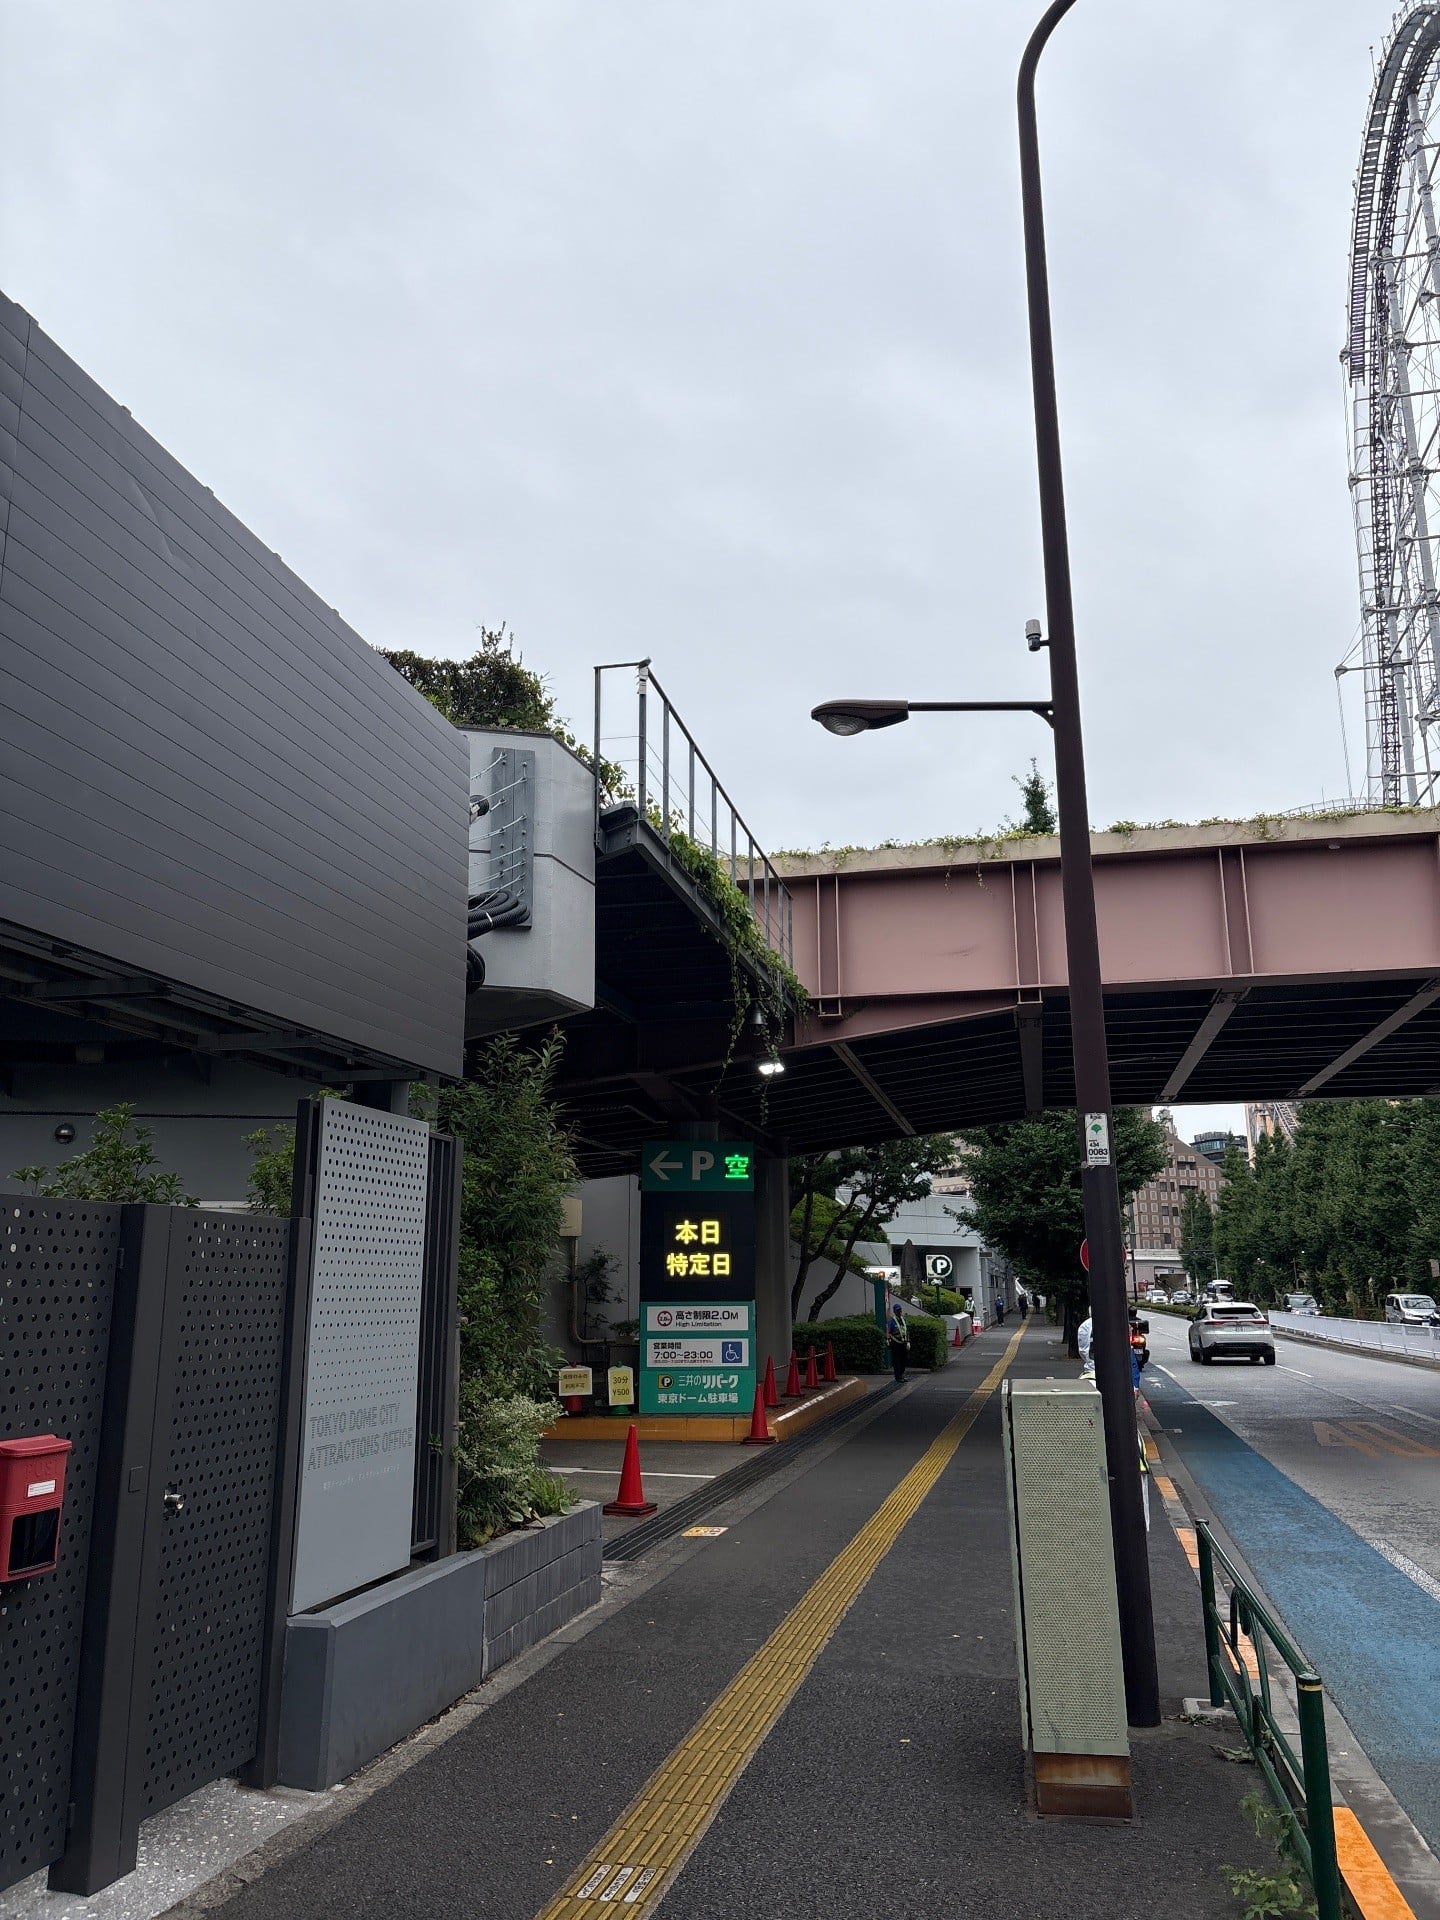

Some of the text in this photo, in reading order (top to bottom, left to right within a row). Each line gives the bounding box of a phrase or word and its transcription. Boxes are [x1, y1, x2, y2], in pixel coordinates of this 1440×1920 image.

[692, 1151, 749, 1180] P 空
[675, 1220, 720, 1245] 本日
[666, 1253, 731, 1277] 特定日
[936, 1259, 948, 1274] P
[653, 1342, 682, 1350] 営業時間
[612, 1376, 629, 1385] 30分
[678, 1374, 739, 1390] 三井のリパーク
[657, 1392, 739, 1404] 東京ドーム駐車場
[309, 1402, 401, 1439] TOKYO DOME CITY
[307, 1426, 414, 1471] ATTRACTIONS OFFICE
[1312, 1421, 1440, 1459] 40
